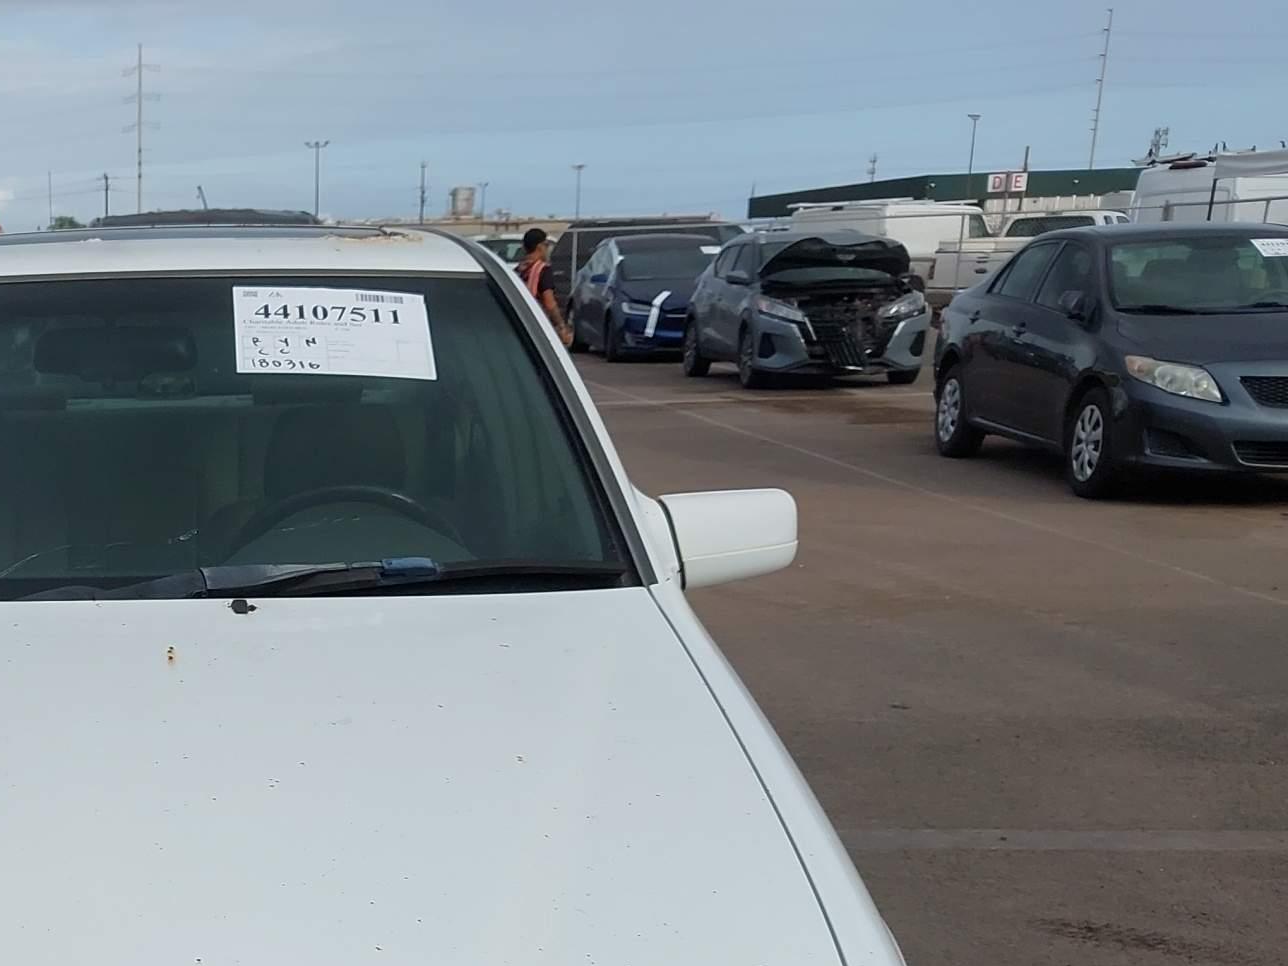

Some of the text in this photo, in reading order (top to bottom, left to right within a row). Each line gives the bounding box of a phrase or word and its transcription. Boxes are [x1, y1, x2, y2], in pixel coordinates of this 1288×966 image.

[992, 175, 1024, 190] D E
[254, 303, 401, 325] 44107511
[251, 358, 321, 370] 180316
